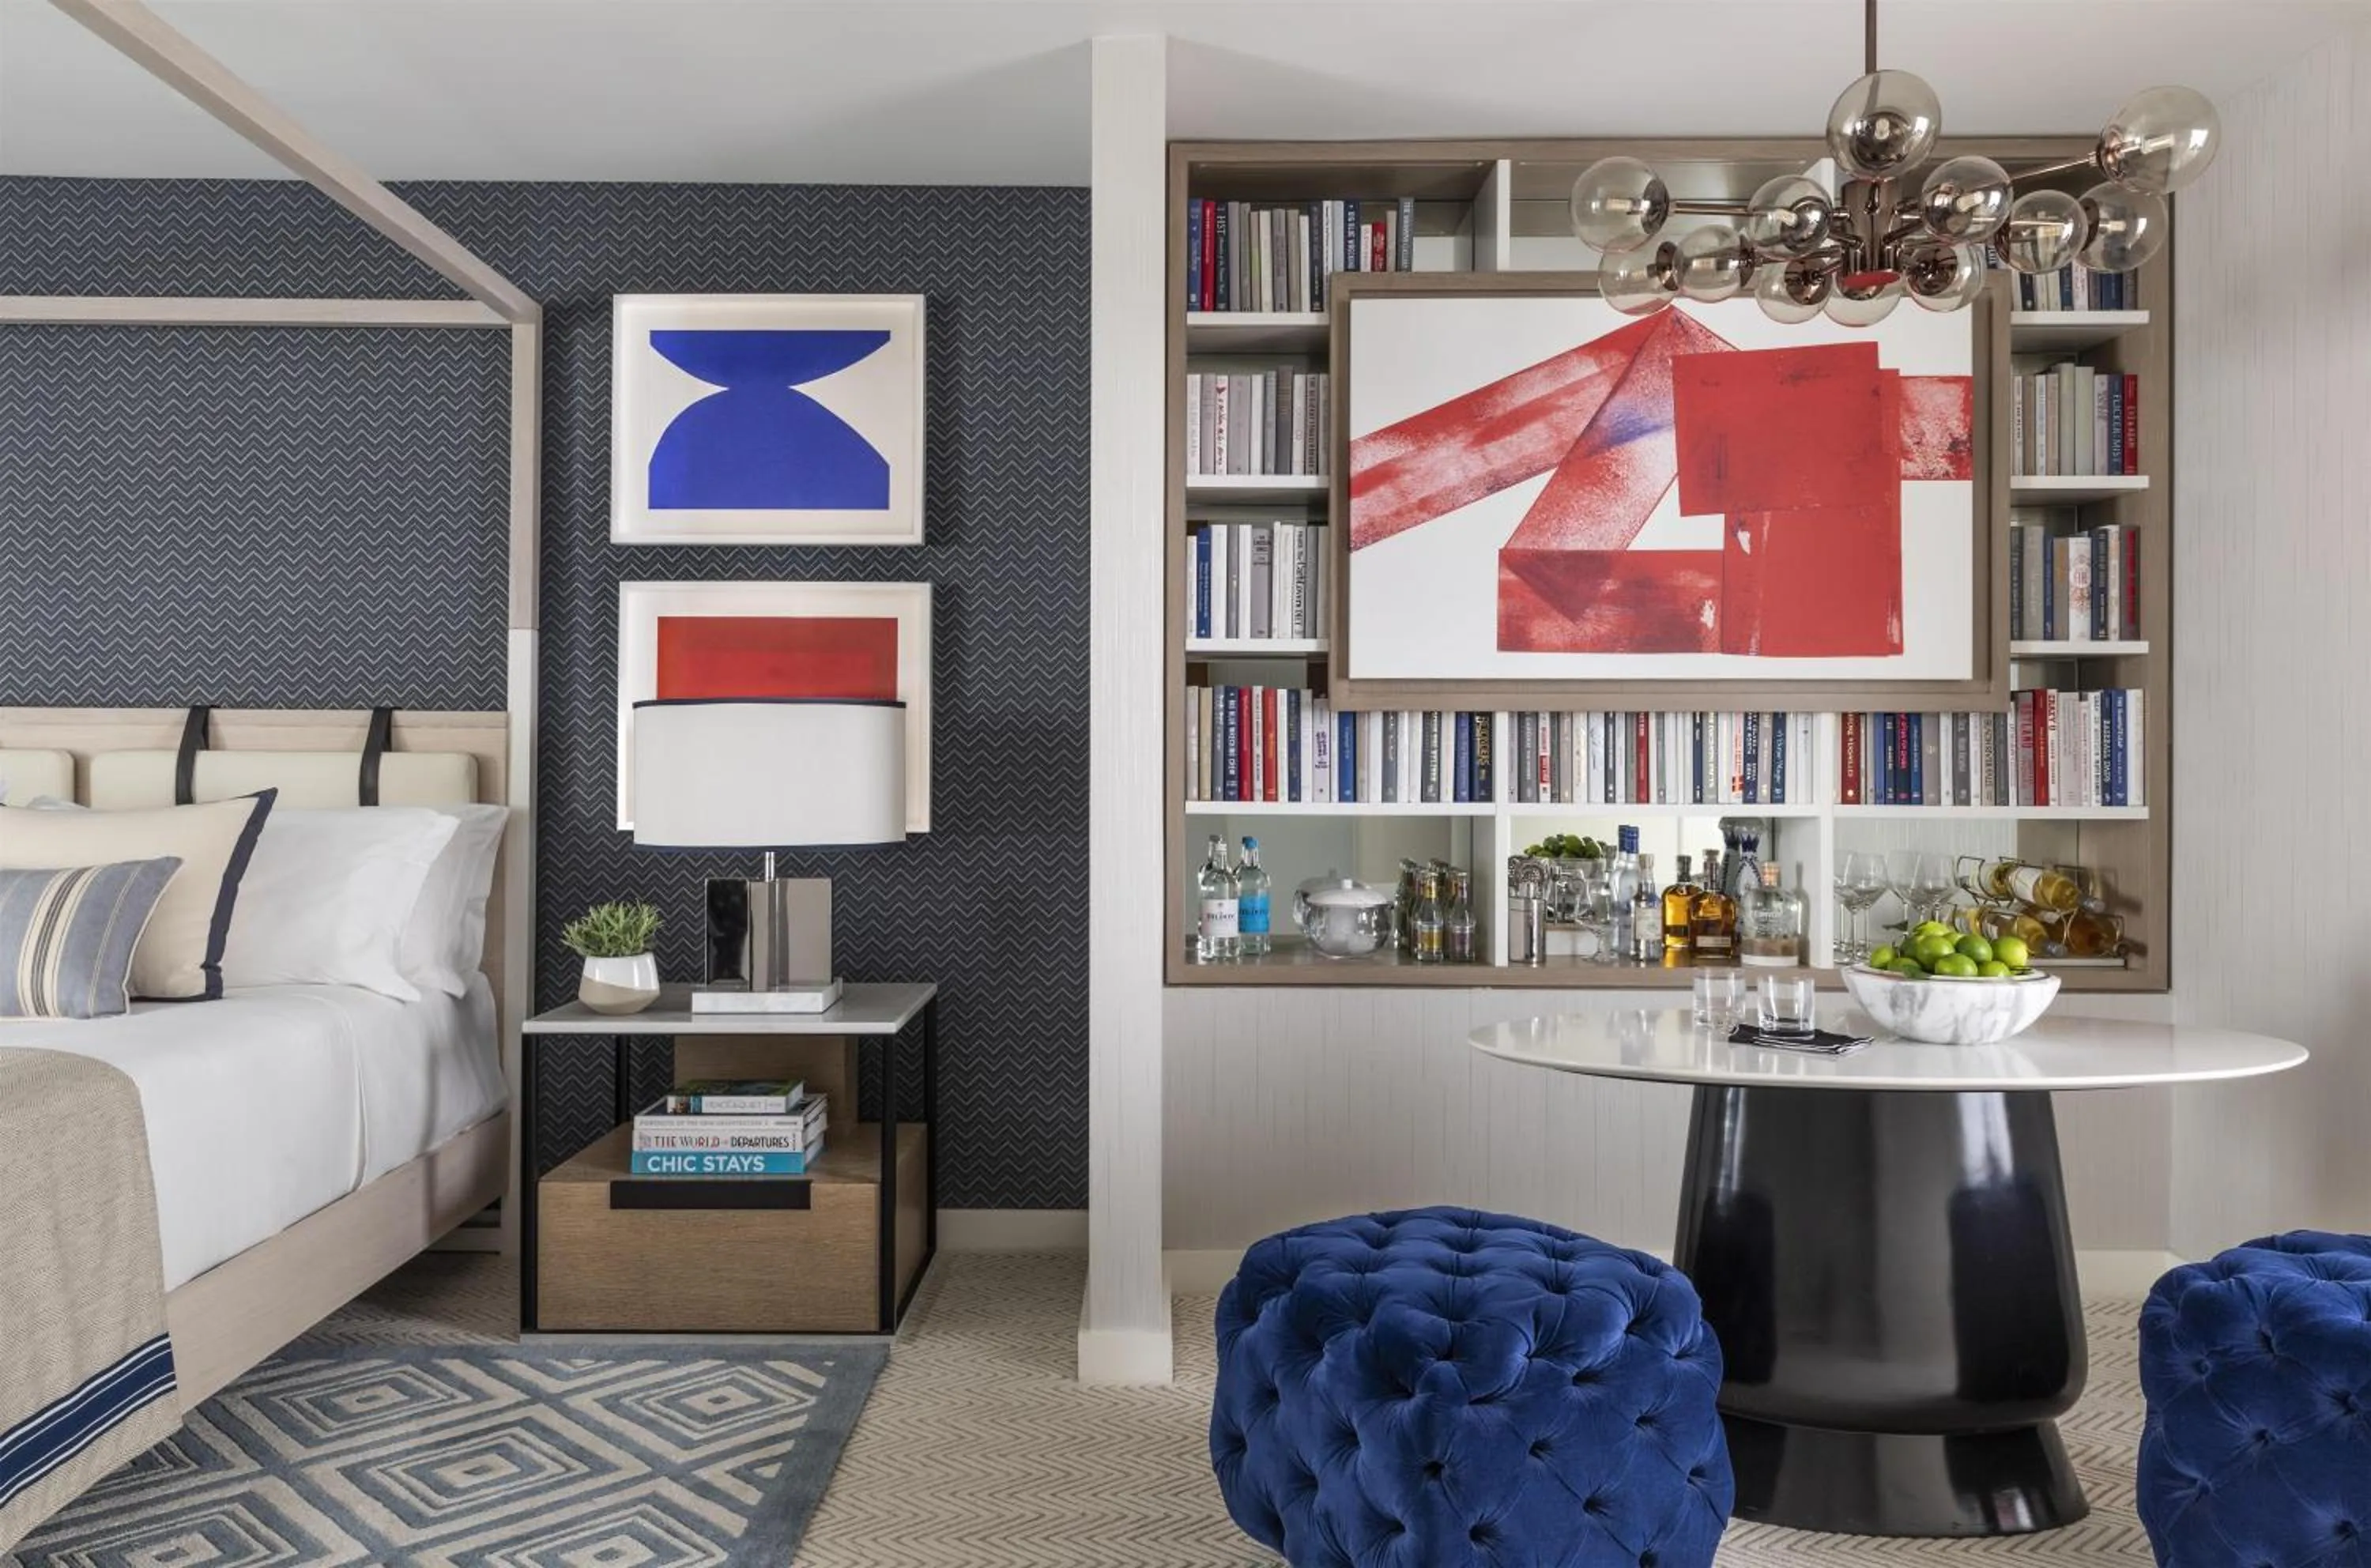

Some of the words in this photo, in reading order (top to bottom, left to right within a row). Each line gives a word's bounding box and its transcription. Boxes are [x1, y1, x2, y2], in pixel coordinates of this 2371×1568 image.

[654, 1136, 677, 1148] THE
[680, 1136, 720, 1148] WORLD
[731, 1136, 790, 1148] DEPARTURES
[647, 1155, 696, 1173] CHIC
[703, 1155, 765, 1173] STAYS
